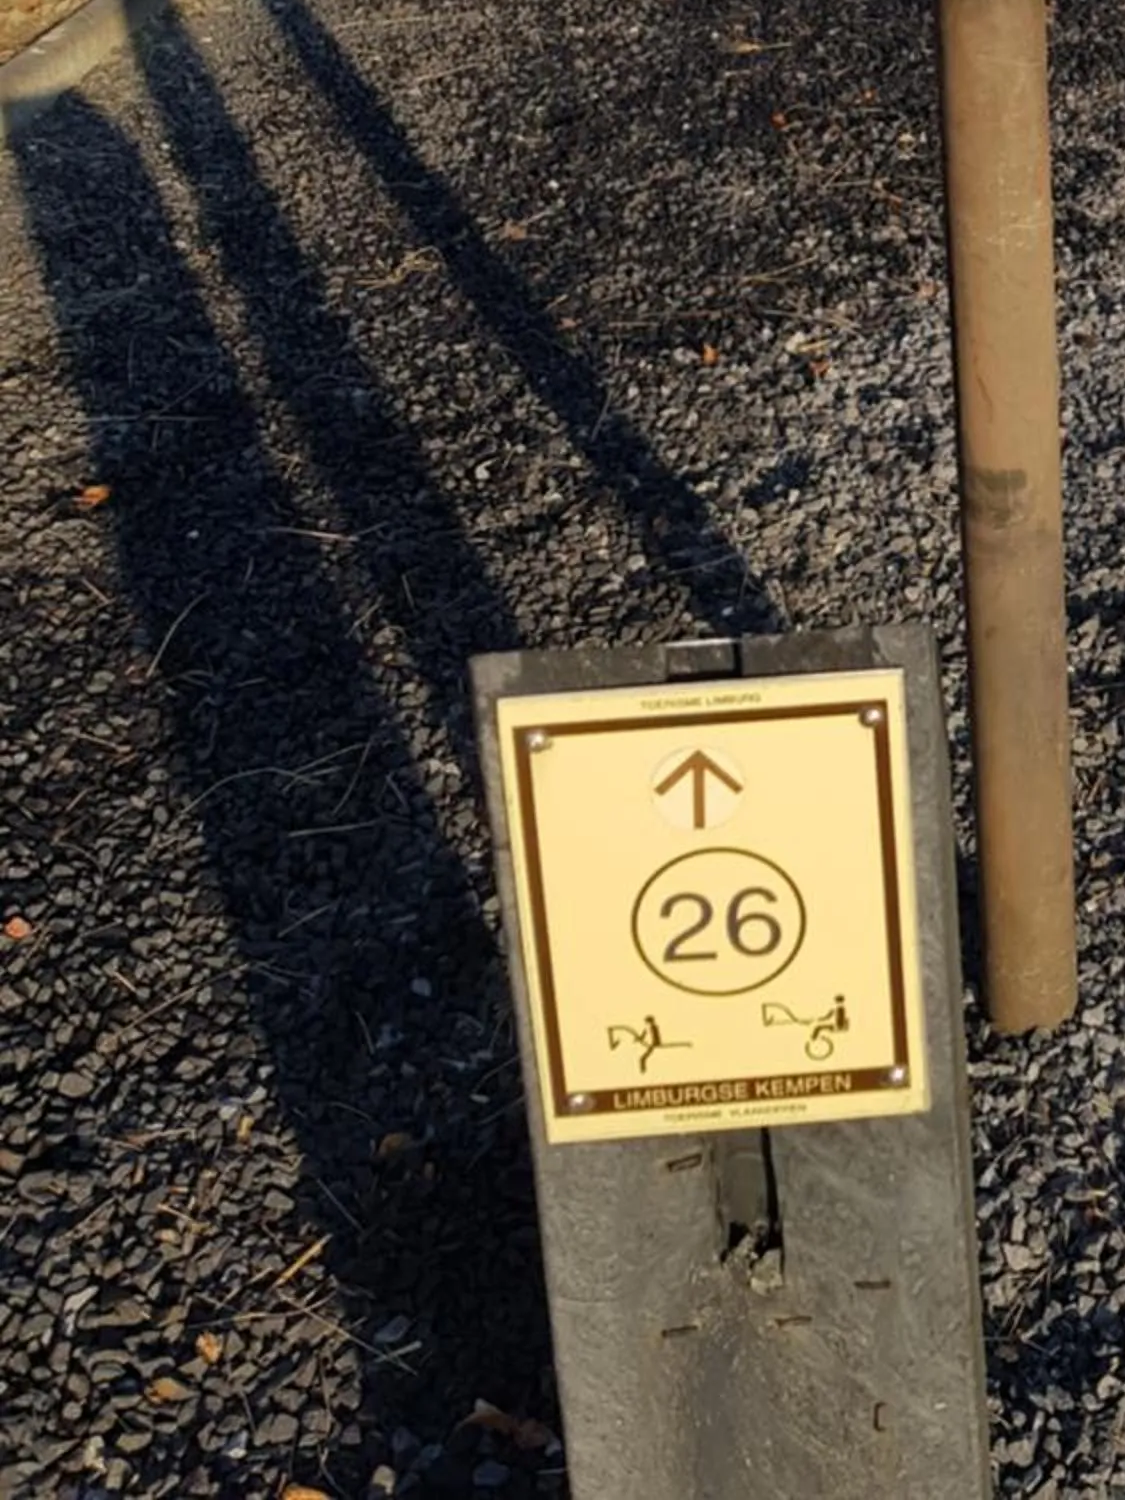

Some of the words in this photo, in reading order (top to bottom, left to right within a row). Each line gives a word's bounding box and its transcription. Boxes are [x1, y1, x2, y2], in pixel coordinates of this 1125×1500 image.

[660, 887, 781, 962] 26
[613, 1082, 748, 1109] LIMBURGSE
[755, 1073, 853, 1098] KEMPEN
